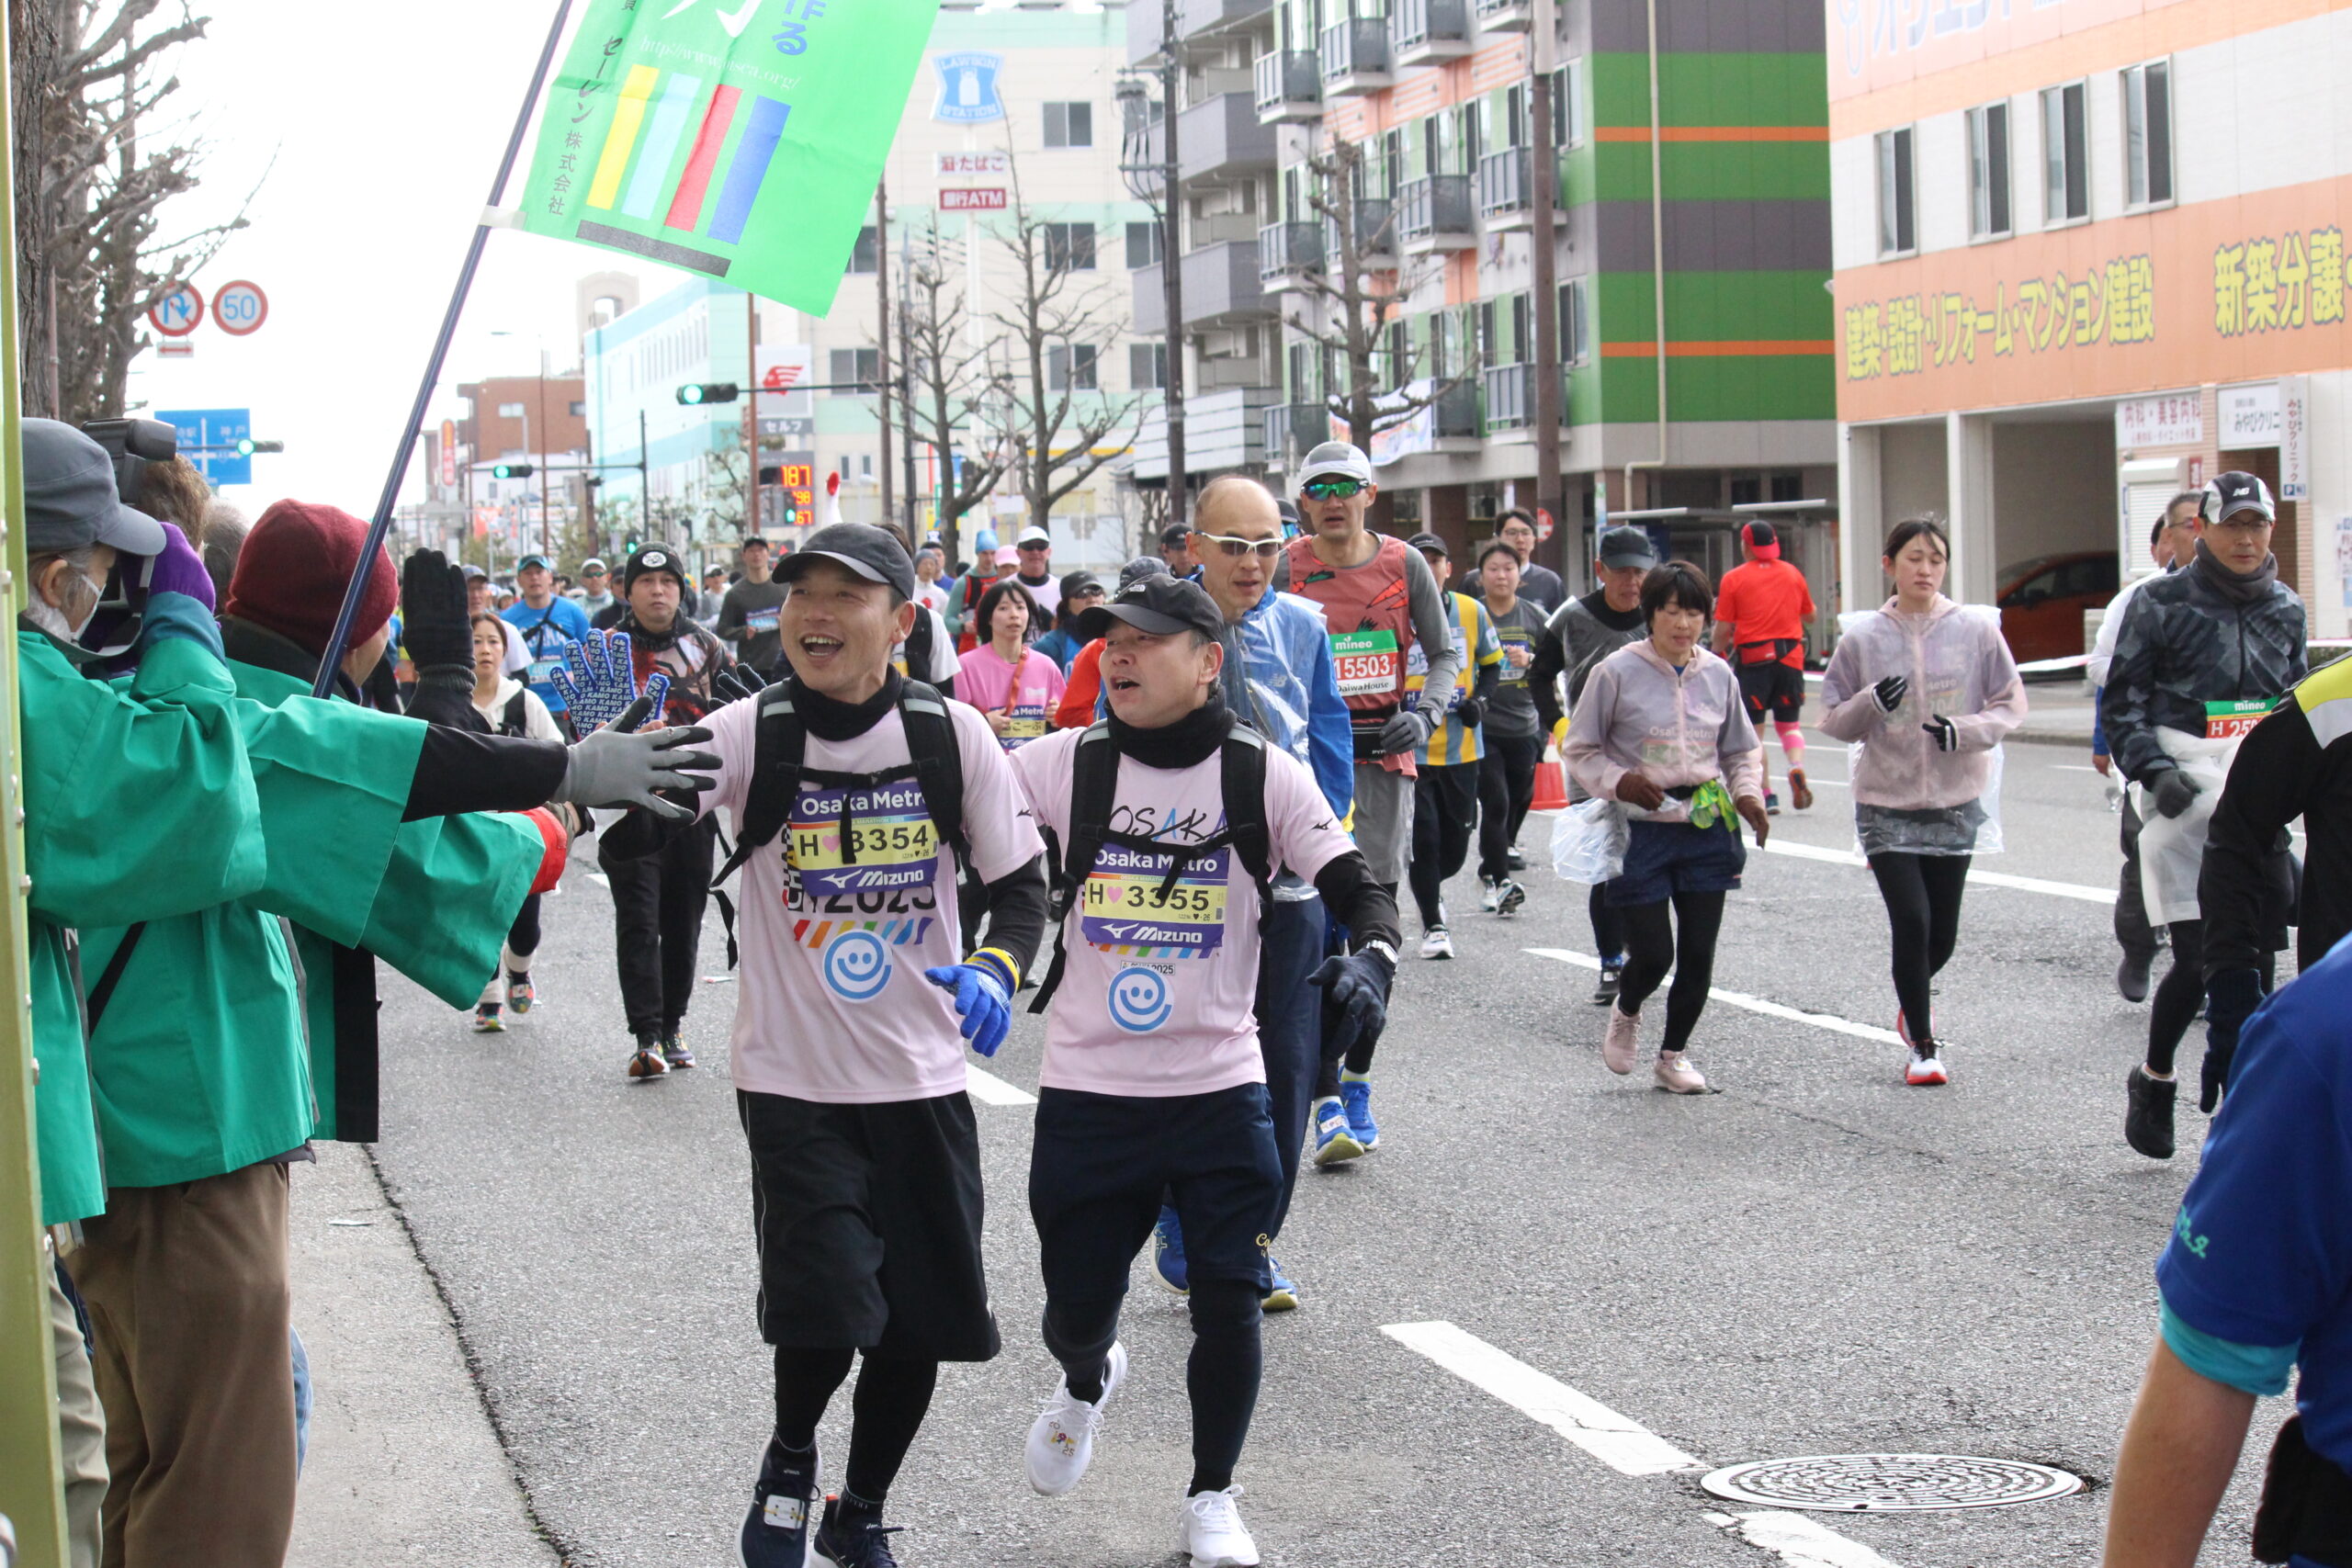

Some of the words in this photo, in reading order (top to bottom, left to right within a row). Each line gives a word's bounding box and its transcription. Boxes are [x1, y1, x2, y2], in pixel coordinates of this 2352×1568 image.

[548, 35, 624, 217] セーレン株式会社
[943, 190, 1003, 208] 銀行ATM
[223, 294, 256, 321] 50
[1844, 254, 2155, 382] 建築・設計・リフォーム・マンション建設
[764, 420, 802, 434] セルフ
[781, 465, 812, 488] 187
[1335, 636, 1373, 650] mineo
[1334, 654, 1391, 680] 15503
[1363, 680, 1390, 691] House
[2233, 700, 2266, 711] mineo
[2211, 721, 2223, 736] H
[801, 795, 869, 816] Osaka
[873, 790, 928, 810] Metr
[799, 834, 820, 856] H
[1094, 848, 1154, 869] Osaka
[1157, 852, 1218, 873] Mtro
[1089, 883, 1104, 905] H
[1126, 885, 1210, 911] 3355
